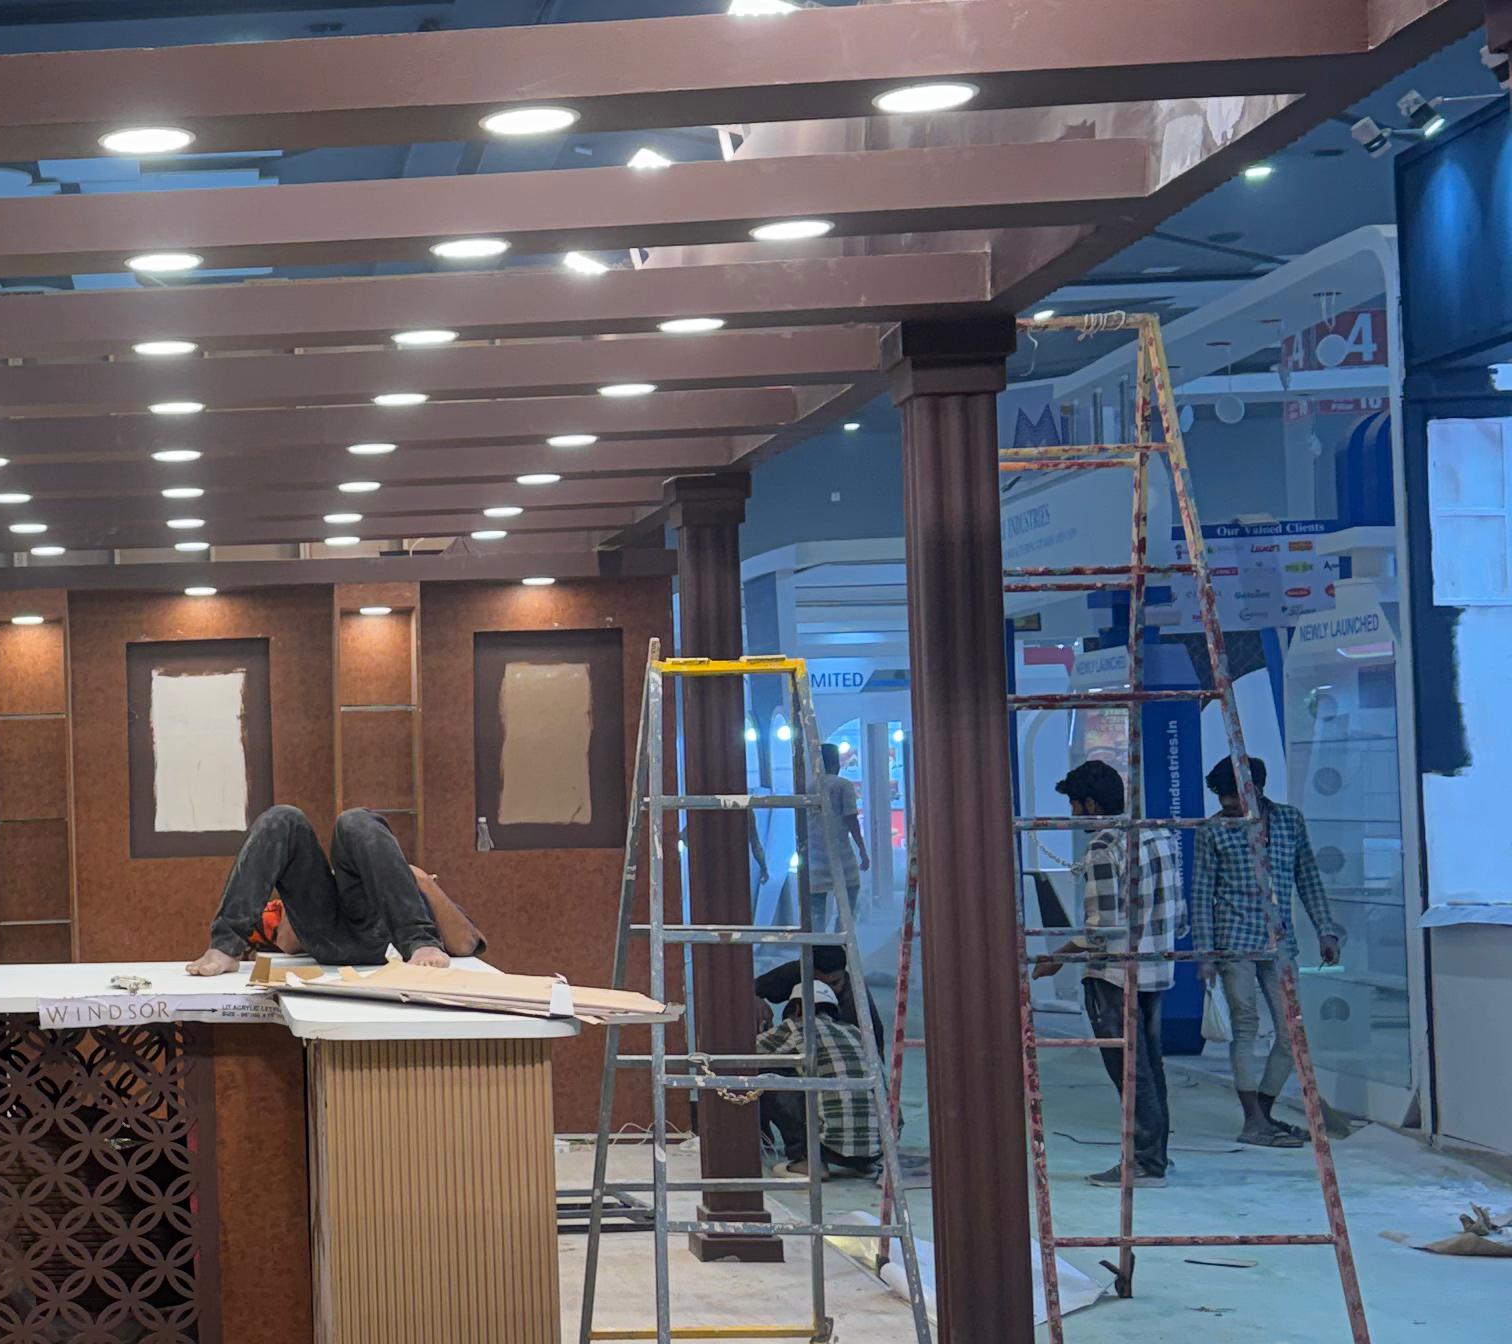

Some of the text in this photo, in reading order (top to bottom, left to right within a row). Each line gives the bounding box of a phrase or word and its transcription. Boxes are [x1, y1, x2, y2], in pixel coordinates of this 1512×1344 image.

[1347, 312, 1377, 361] 4
[1217, 526, 1240, 537] Our
[1286, 522, 1325, 533] Clients
[1299, 614, 1378, 642] NEWLY LAUNCHED
[811, 672, 863, 688] MITED
[45, 1001, 170, 1024] WINDSOR
